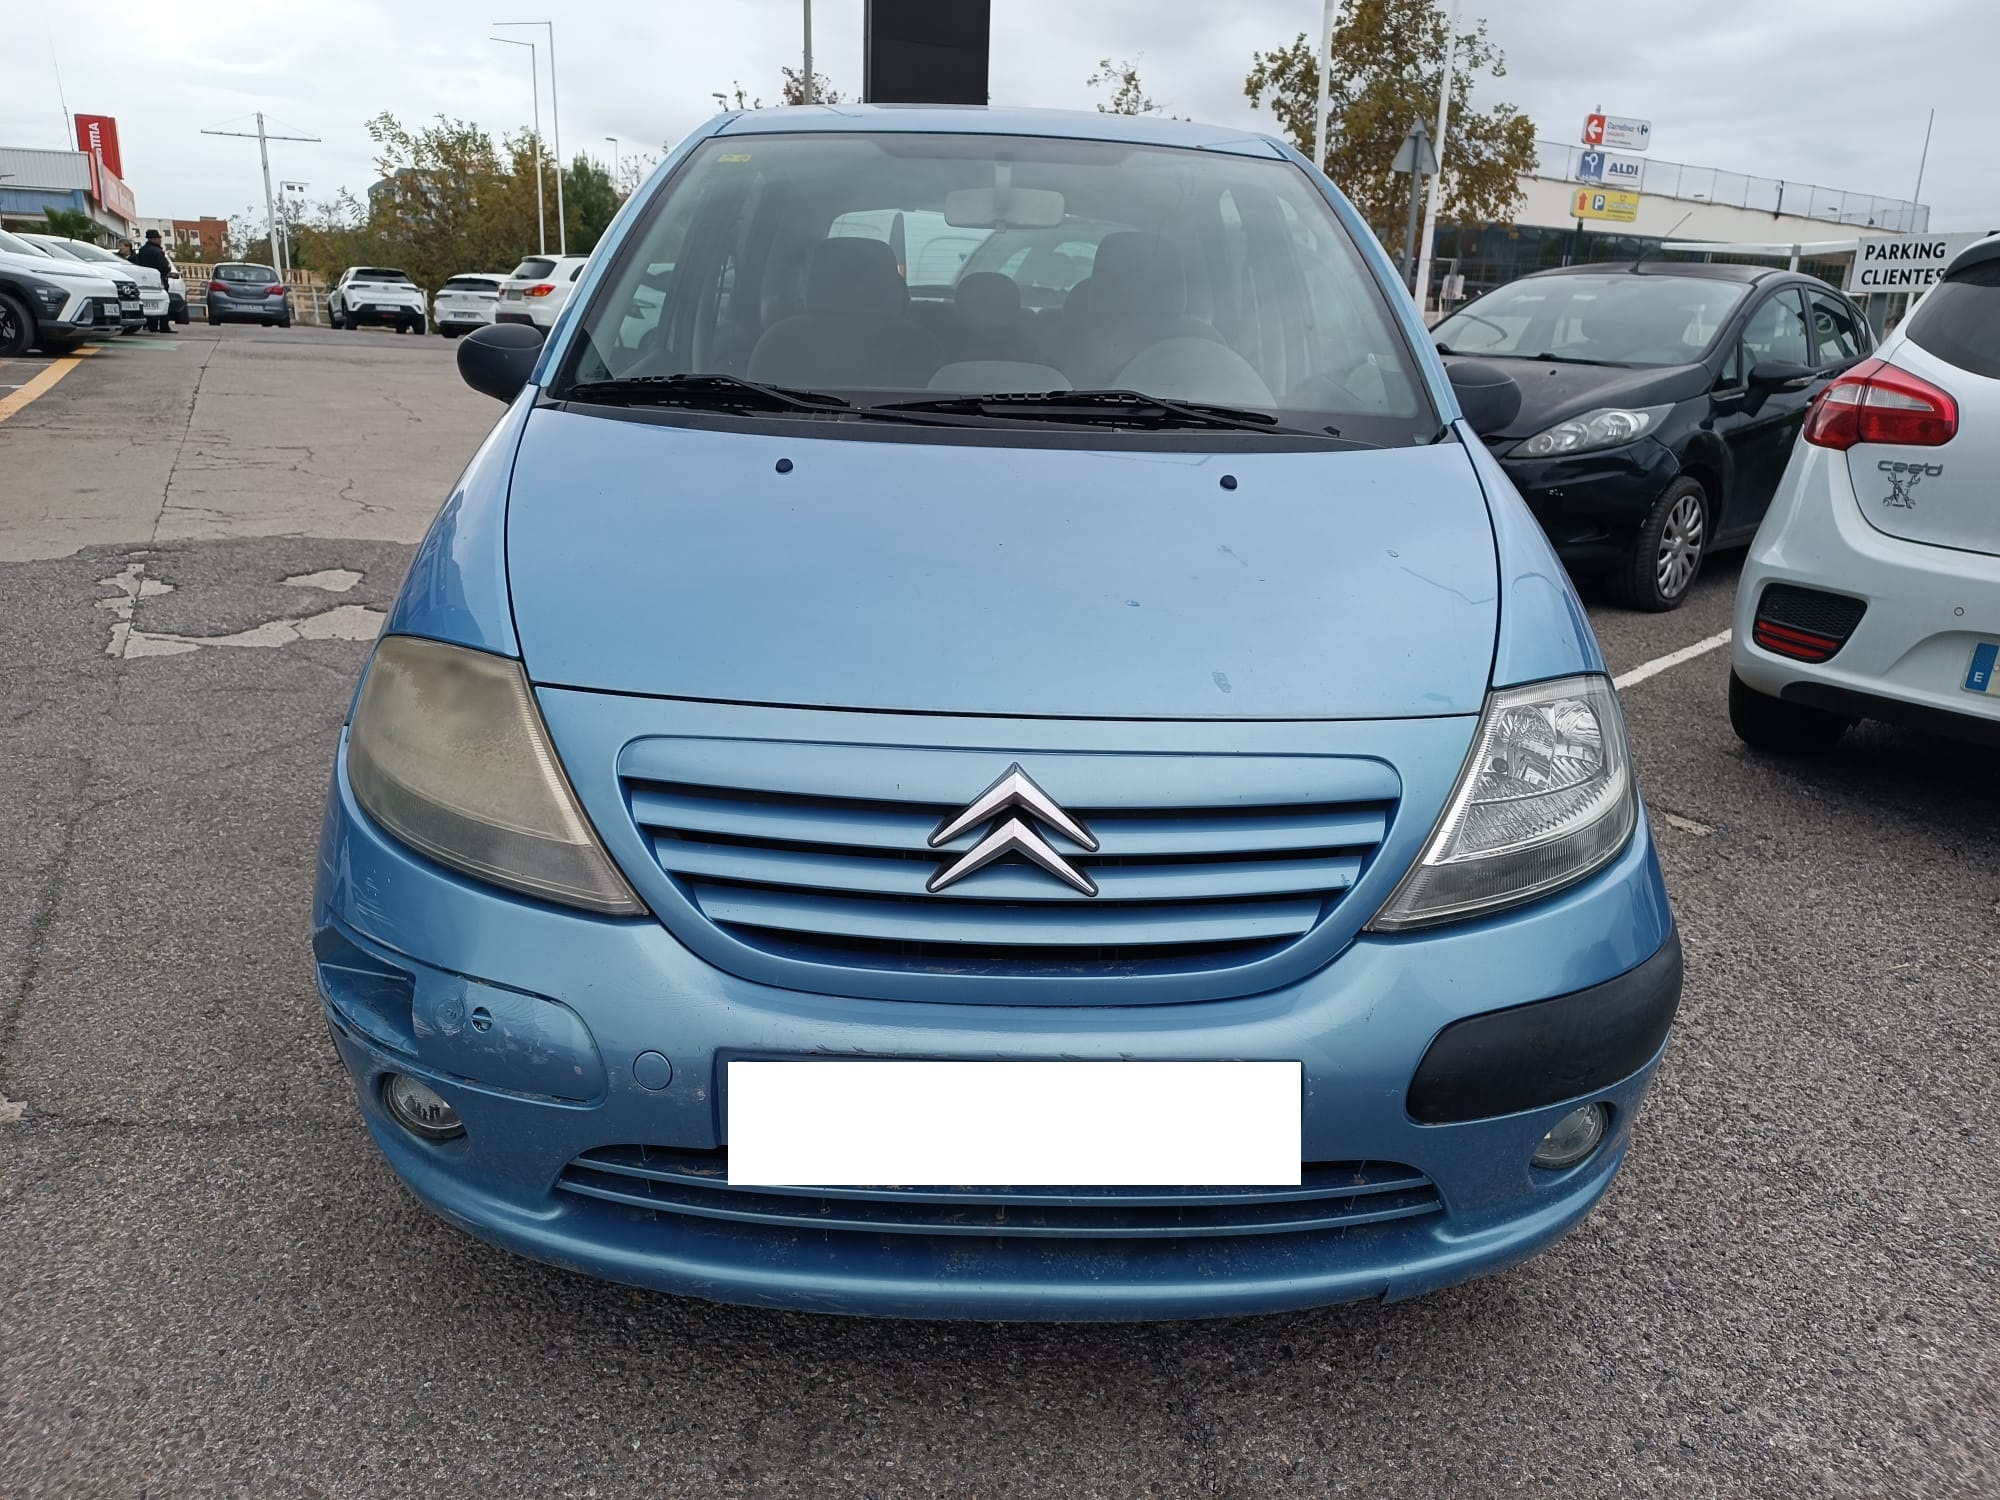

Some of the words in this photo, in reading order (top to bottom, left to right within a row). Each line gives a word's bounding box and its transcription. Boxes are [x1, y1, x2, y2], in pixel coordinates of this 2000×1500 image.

[1608, 162, 1639, 176] ALDI
[1864, 242, 1946, 261] PARKING
[1973, 671, 1985, 683] E
